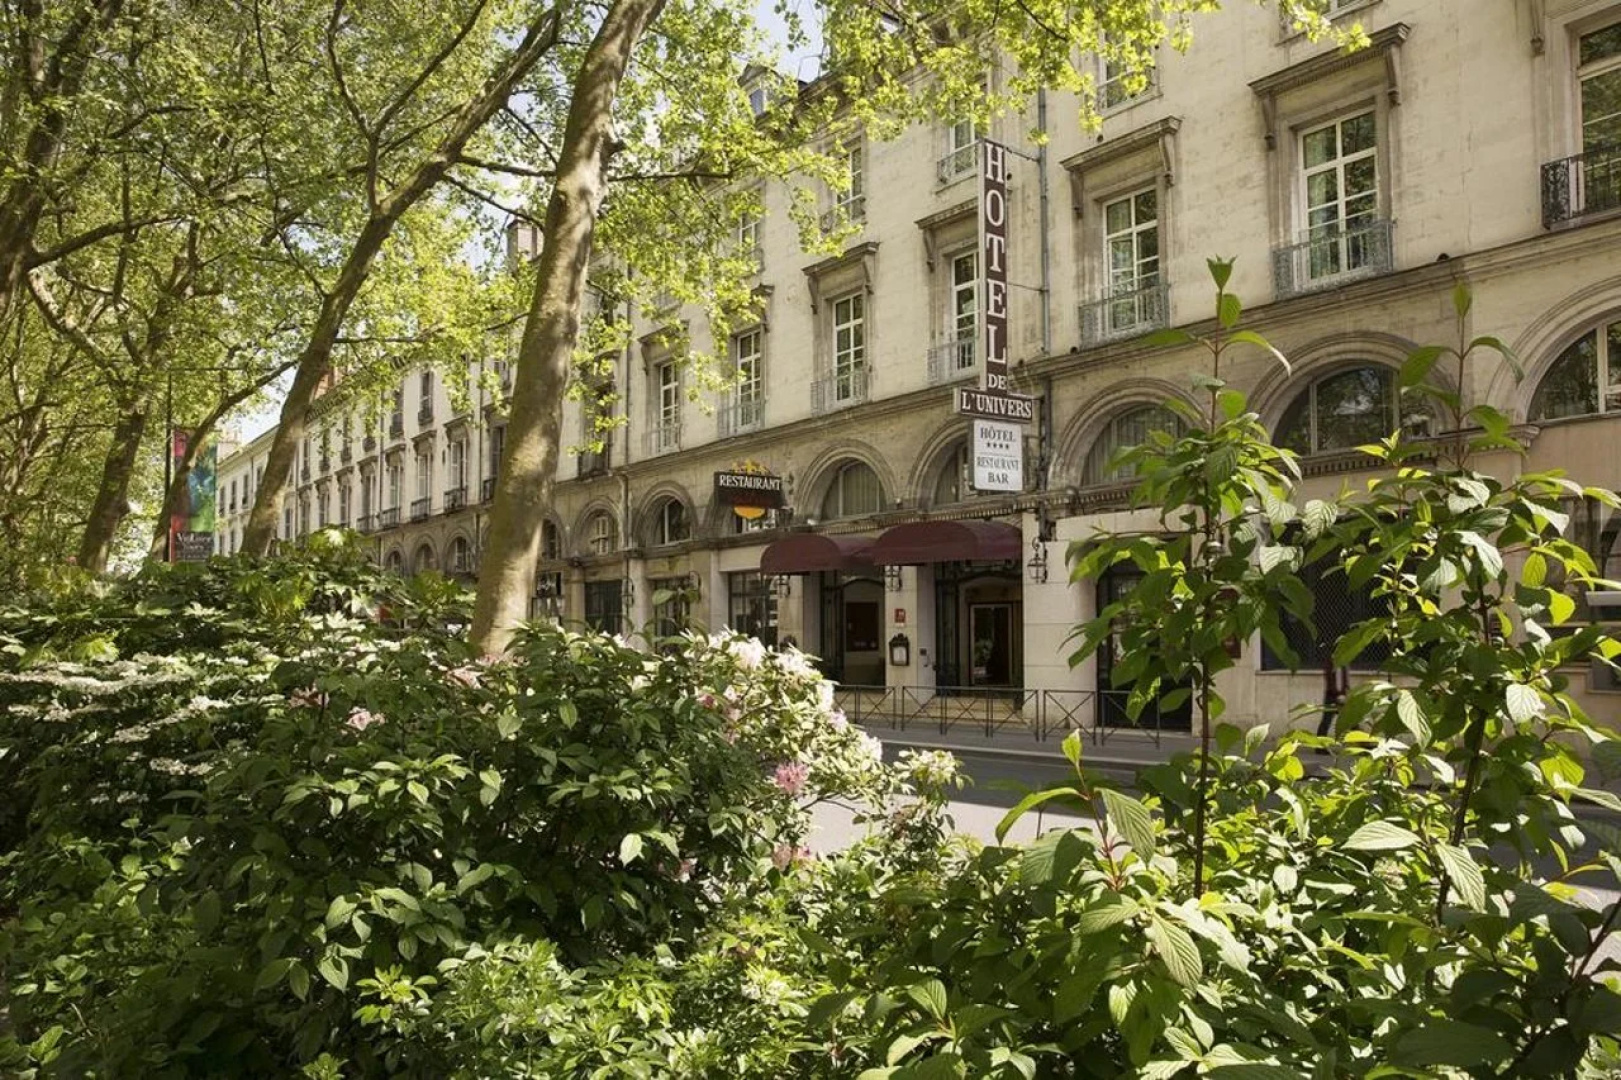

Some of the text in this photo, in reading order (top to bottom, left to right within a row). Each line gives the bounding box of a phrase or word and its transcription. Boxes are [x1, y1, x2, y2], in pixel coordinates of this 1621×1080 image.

[986, 142, 1006, 363] HOTEL
[988, 373, 1007, 390] DE
[962, 392, 1032, 418] L'UNIVERS
[719, 475, 780, 491] RESTAURANT
[988, 472, 1009, 484] BAR
